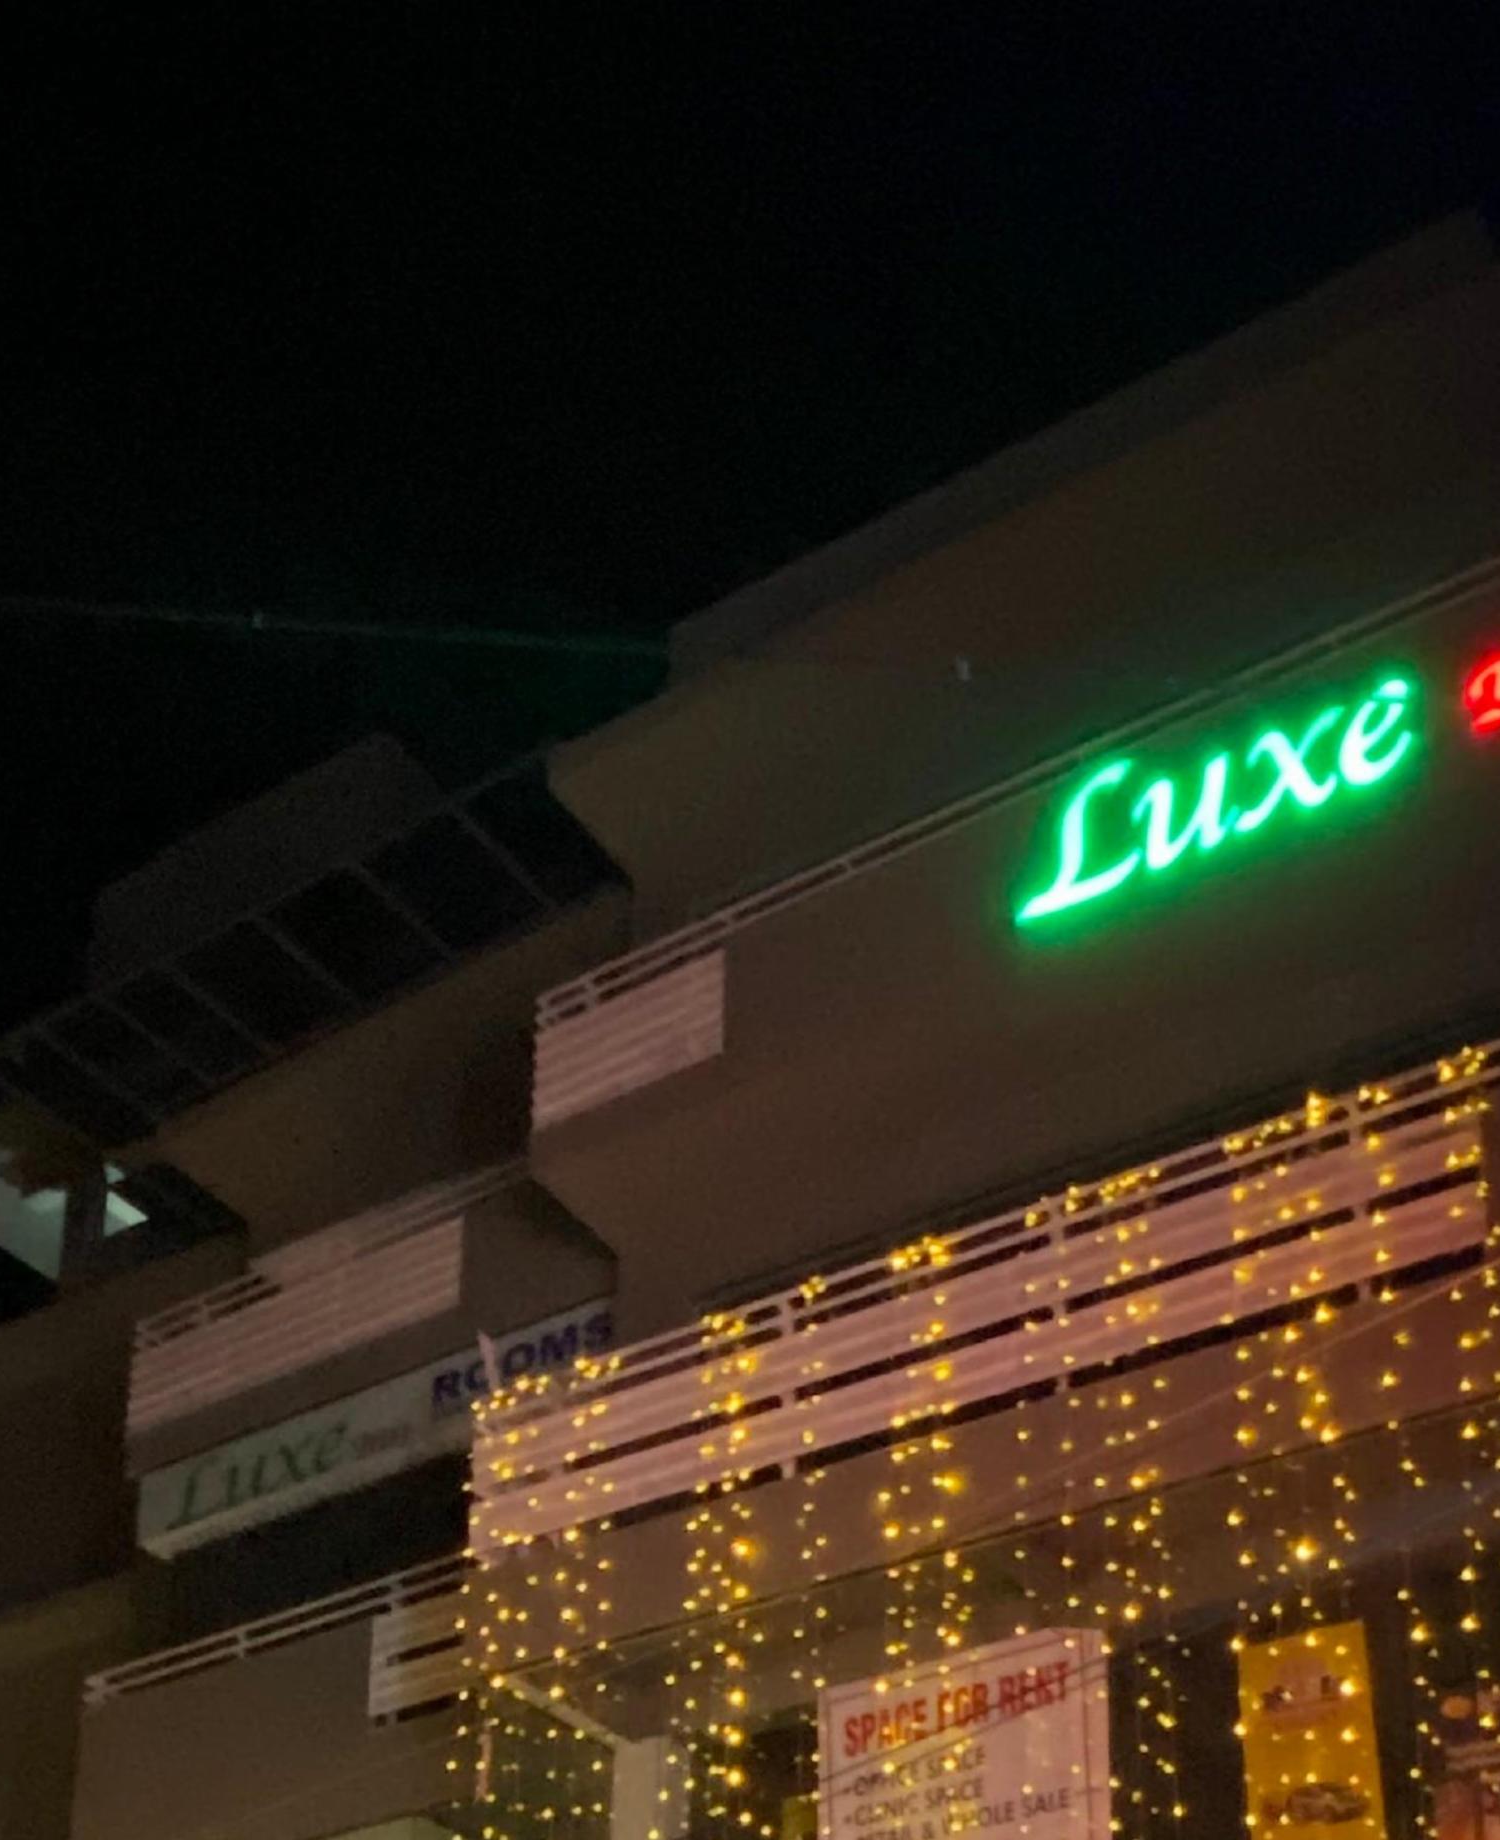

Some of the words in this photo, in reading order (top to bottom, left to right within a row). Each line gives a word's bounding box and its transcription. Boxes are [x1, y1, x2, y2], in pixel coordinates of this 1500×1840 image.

[1016, 677, 1414, 924] Luxe
[167, 1420, 348, 1531] Luxe
[845, 1698, 928, 1758] SPACE
[1022, 1786, 1071, 1819] SALE
